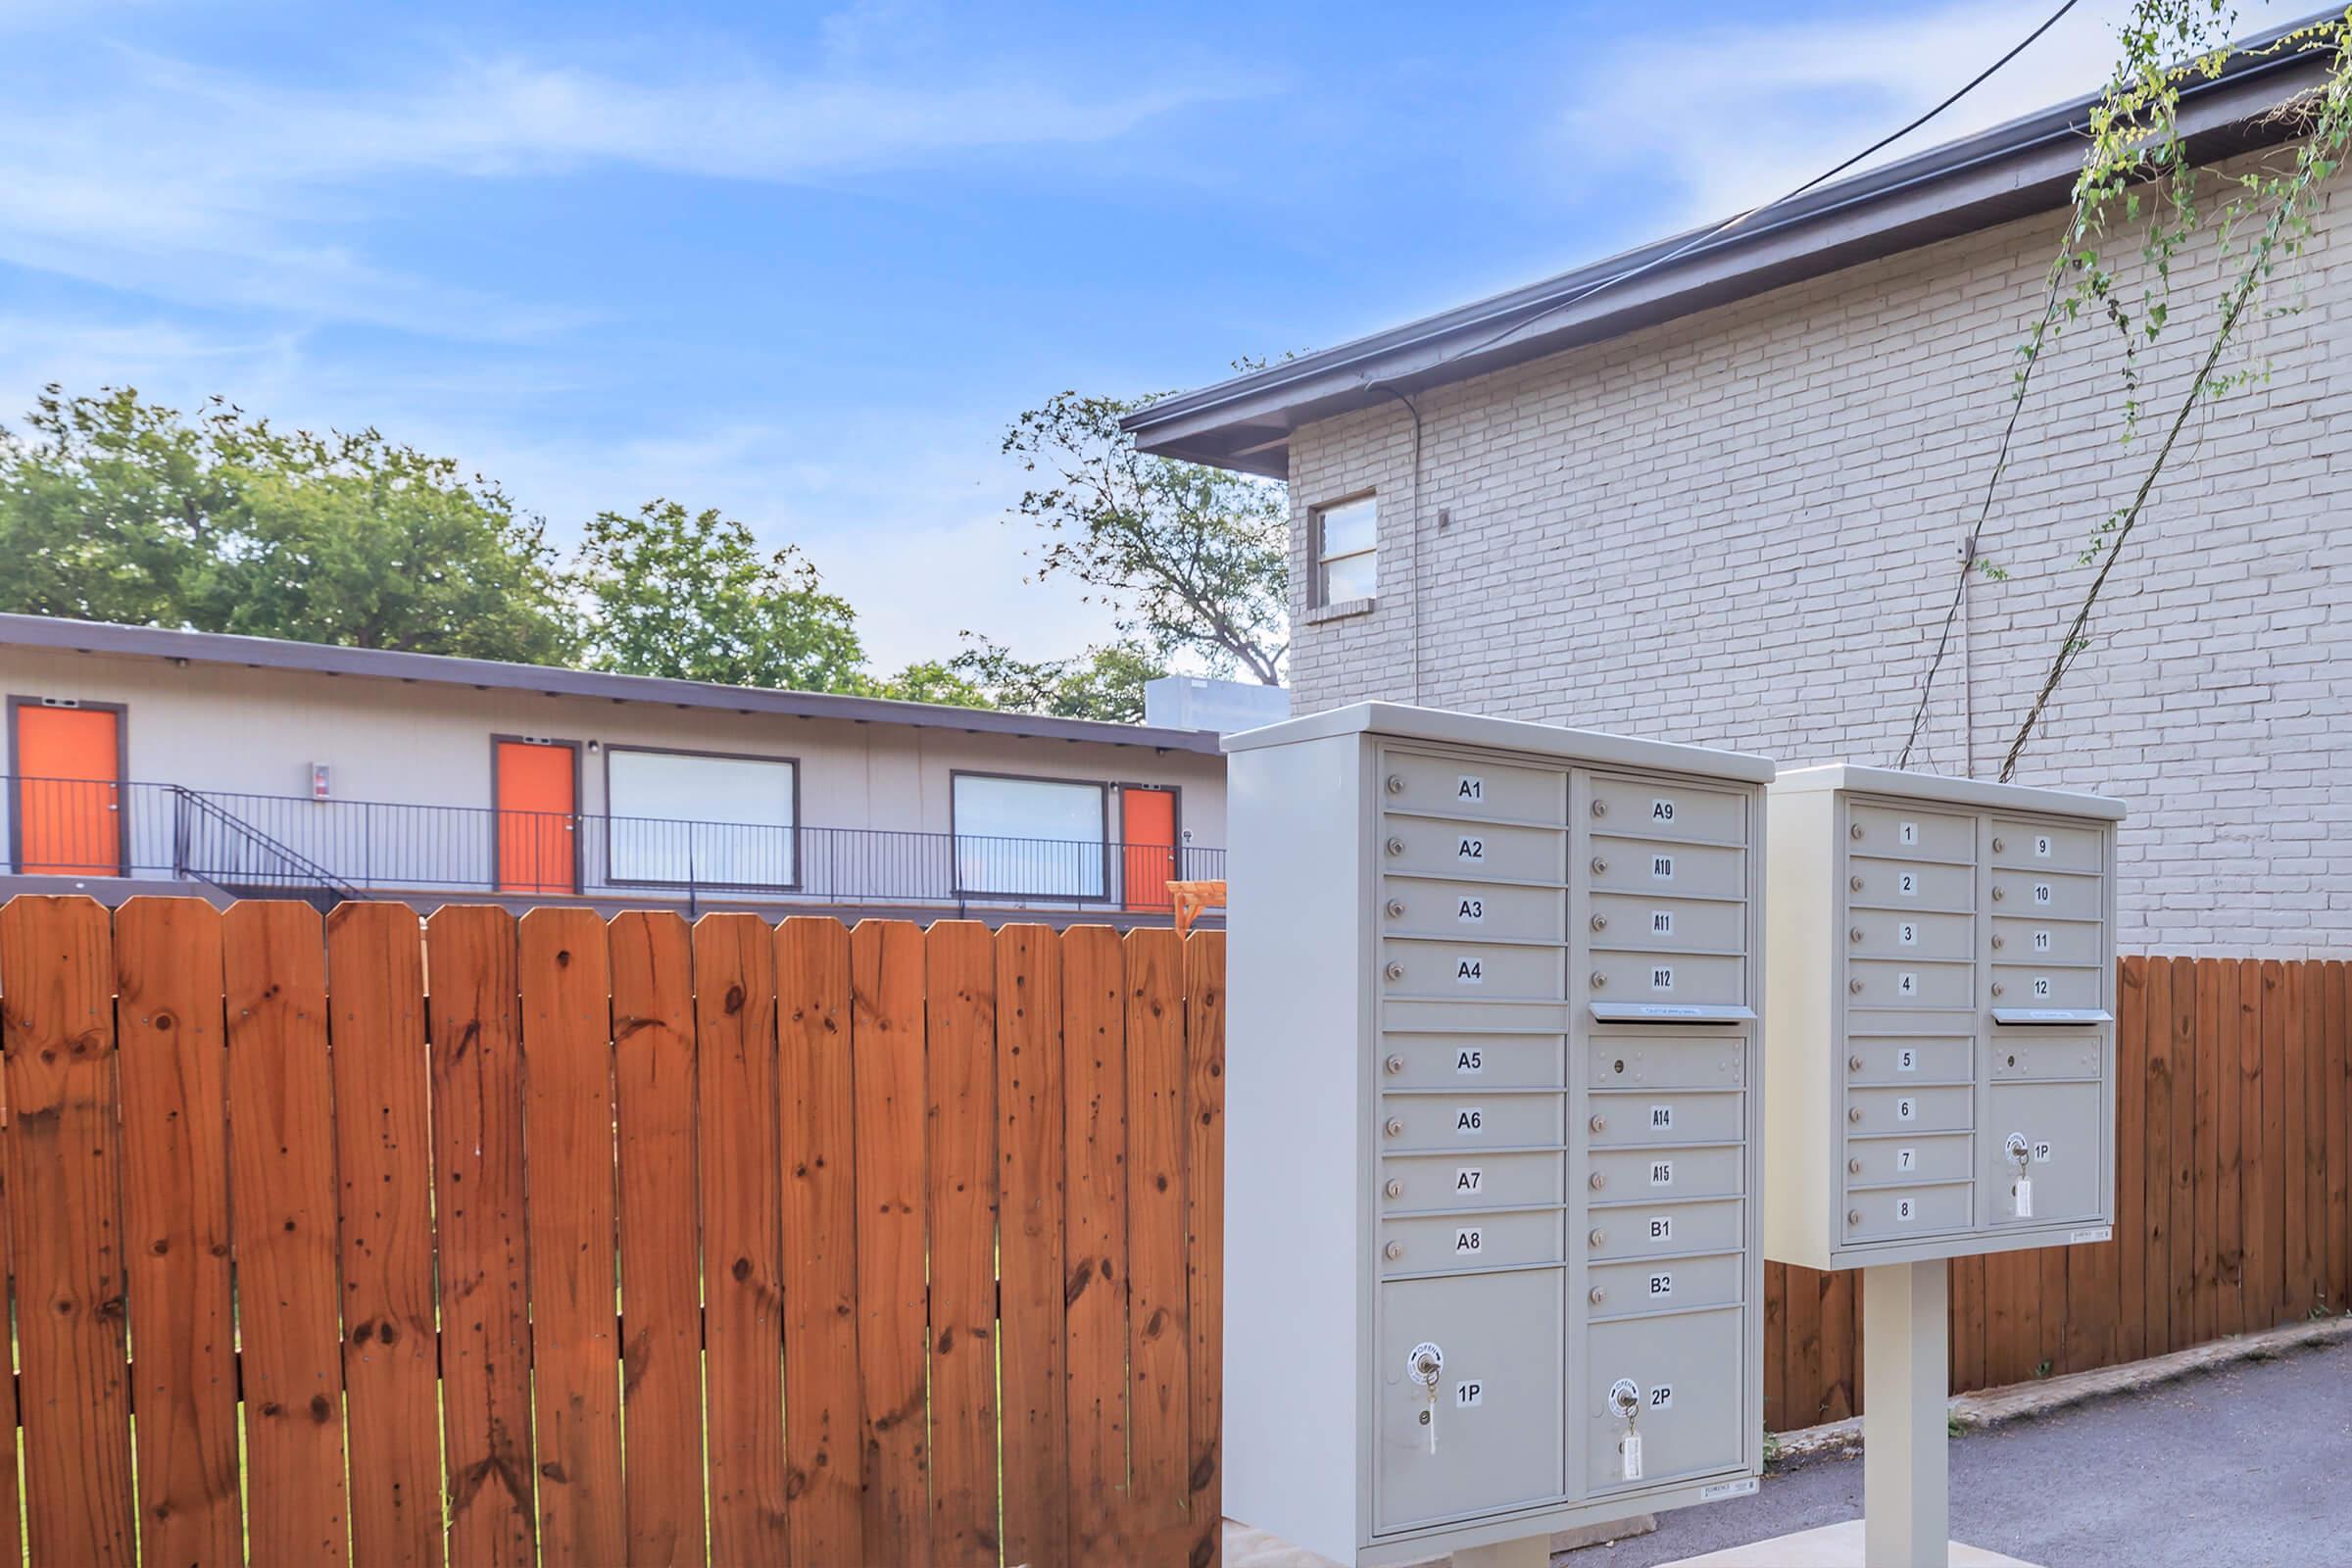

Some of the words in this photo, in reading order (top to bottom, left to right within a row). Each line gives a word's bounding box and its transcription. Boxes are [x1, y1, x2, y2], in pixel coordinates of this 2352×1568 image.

[1458, 779, 1481, 799] A1
[1652, 802, 1674, 820] A9
[1905, 826, 1912, 841] 1
[1458, 840, 1483, 858] A2
[2038, 839, 2047, 854] 9
[1654, 858, 1671, 876] A10
[1903, 876, 1912, 891] 2
[2035, 886, 2048, 901] 10
[1458, 900, 1483, 918] A3
[1653, 914, 1670, 931] A11
[1904, 926, 1913, 941] 3
[2035, 933, 2047, 948] 11
[1457, 961, 1482, 979] A4
[1653, 970, 1671, 987] A12
[1902, 976, 1912, 991] 4
[2034, 980, 2047, 995] 12
[1457, 1052, 1482, 1069] A5
[1903, 1053, 1912, 1067] 5
[1652, 1109, 1670, 1126] A14
[1901, 1102, 1910, 1116] 6
[1457, 1111, 1481, 1130] A6
[1902, 1152, 1911, 1166] 7
[2035, 1145, 2048, 1158] 1P
[1457, 1172, 1481, 1190] A7
[1652, 1165, 1670, 1182] A15
[1901, 1201, 1910, 1217] 8
[1650, 1220, 1669, 1238] B1
[1456, 1232, 1480, 1250] A8
[1651, 1277, 1670, 1294] B2
[1417, 1345, 1437, 1354] OPEN
[1459, 1385, 1480, 1402] 1P
[1616, 1380, 1633, 1390] OPEN
[1651, 1388, 1671, 1405] 2P
